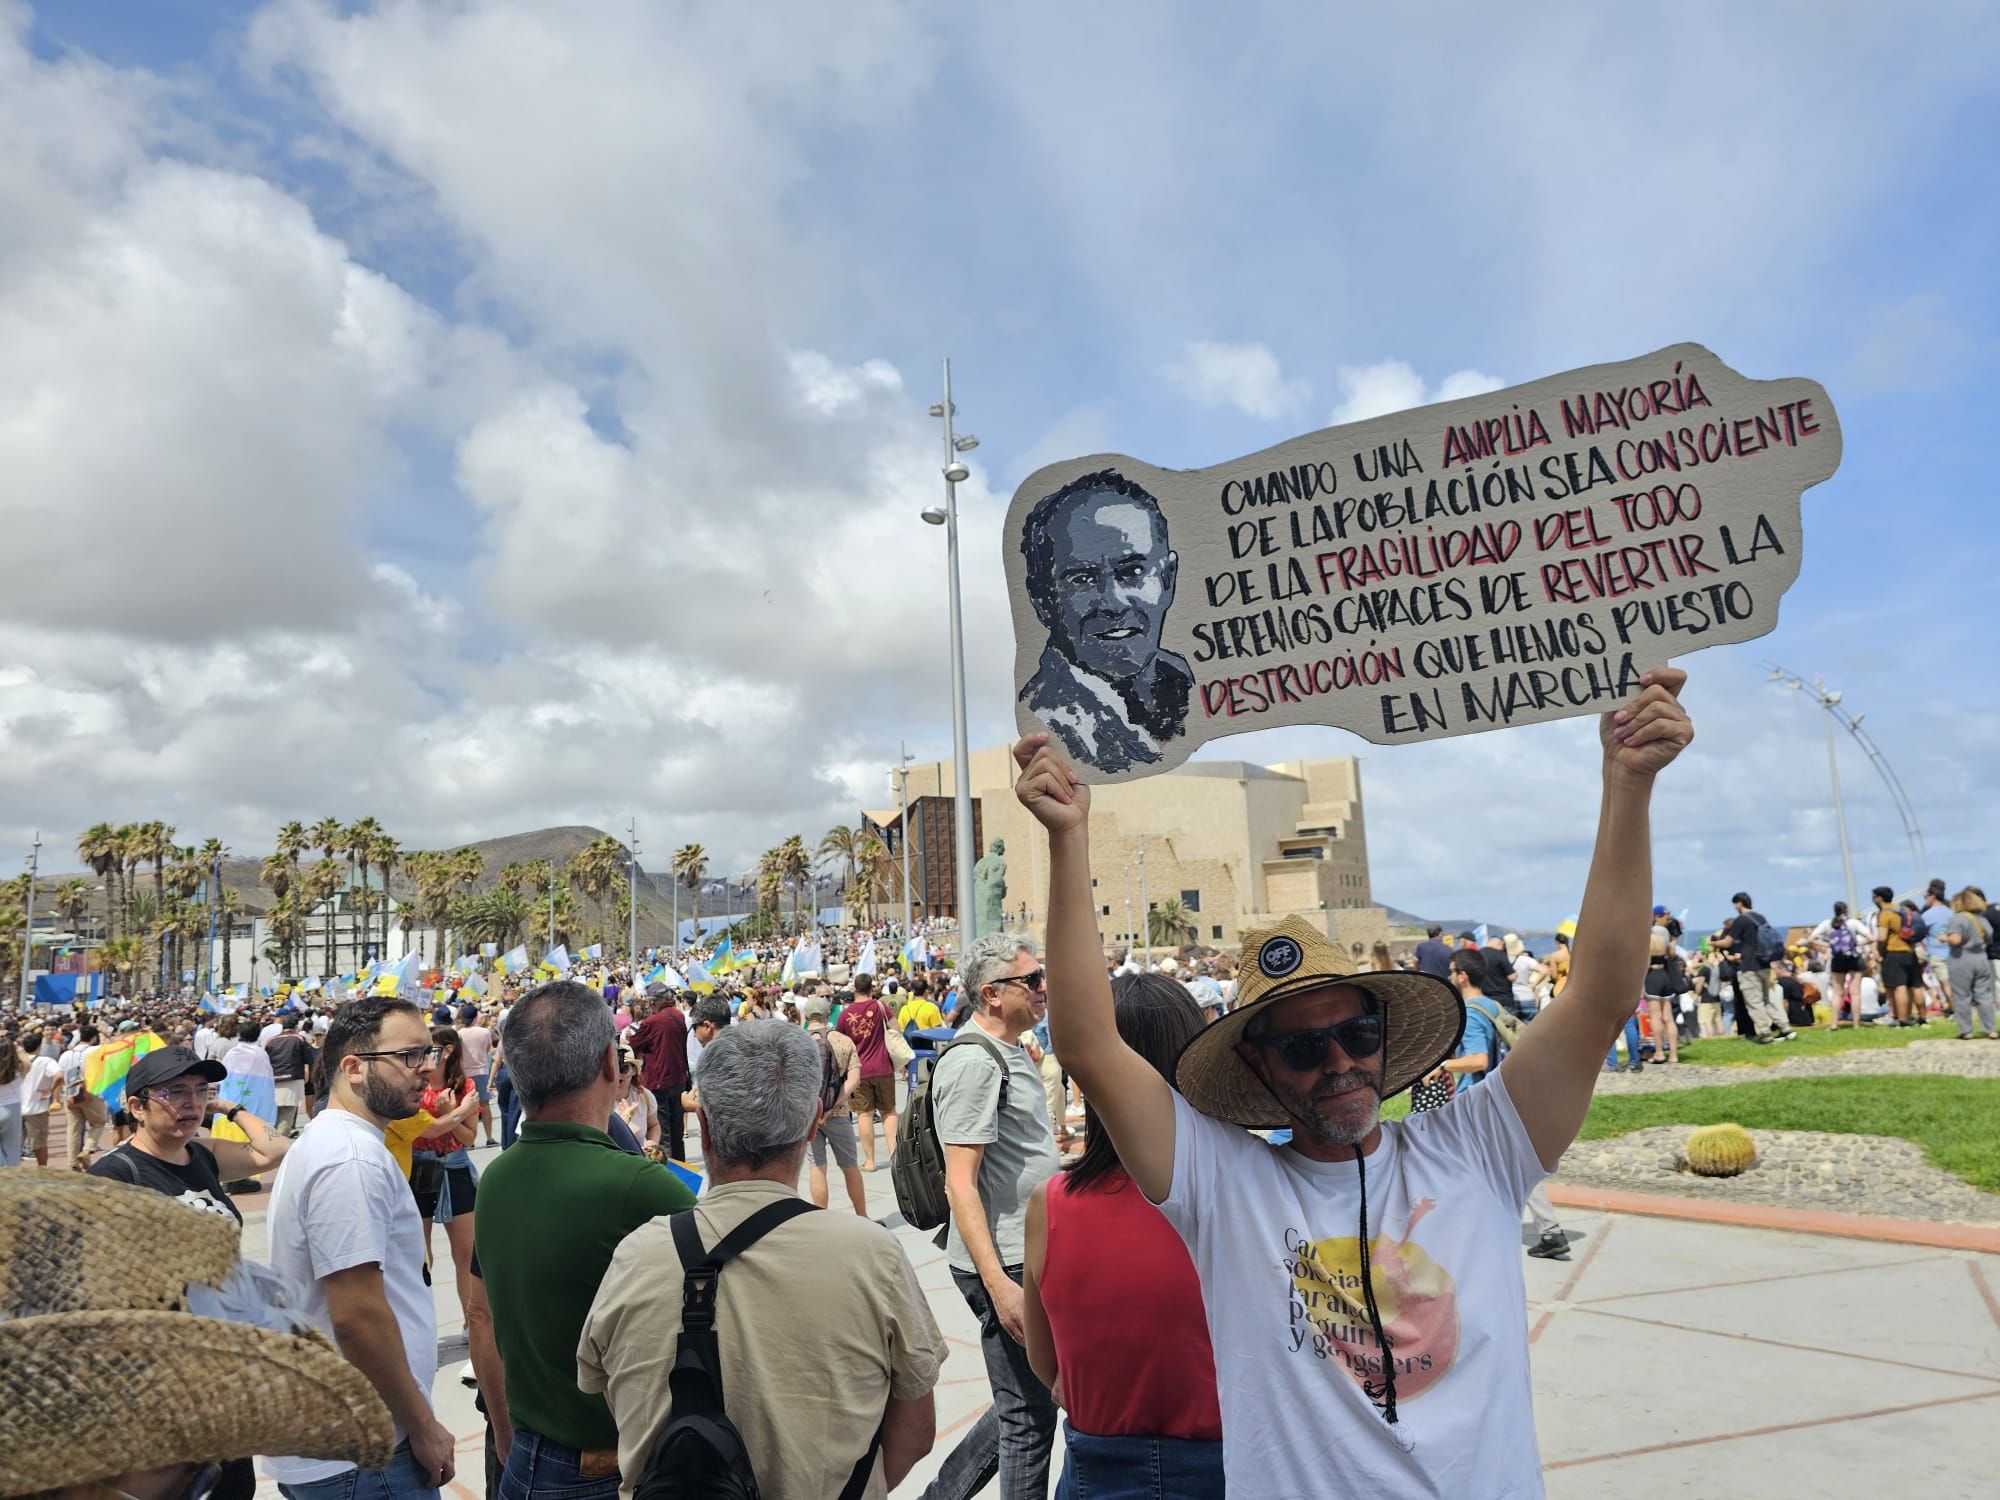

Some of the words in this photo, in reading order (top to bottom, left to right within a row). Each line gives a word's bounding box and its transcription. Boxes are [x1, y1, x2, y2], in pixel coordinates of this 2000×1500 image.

[1221, 462, 1337, 515] CUANDO
[1353, 438, 1424, 481] UNA
[1442, 404, 1552, 469] AMPLIA
[1560, 360, 1712, 438] MAYORÍA
[1205, 570, 1263, 607] DE
[1268, 557, 1312, 600] LA
[1315, 520, 1521, 595] FRAGILIDAD
[1534, 506, 1612, 551] DEL
[1611, 483, 1702, 532] TODO
[1228, 516, 1281, 559] DE
[1539, 446, 1618, 500] SEA
[1192, 604, 1332, 662] SEREMOS
[1334, 578, 1472, 633] CAPACES
[1479, 572, 1532, 615] DE
[1541, 534, 1720, 603] REVERTIR
[1720, 514, 1784, 564] LA
[1201, 639, 1405, 718] DESTRUCCIÓN
[1413, 634, 1488, 679] QUE
[1490, 613, 1606, 664] HEMOS
[1611, 581, 1753, 644] PUESTO
[1381, 688, 1447, 733] EN
[1461, 652, 1645, 723] MARCHA
[1288, 1327, 1305, 1352] y
